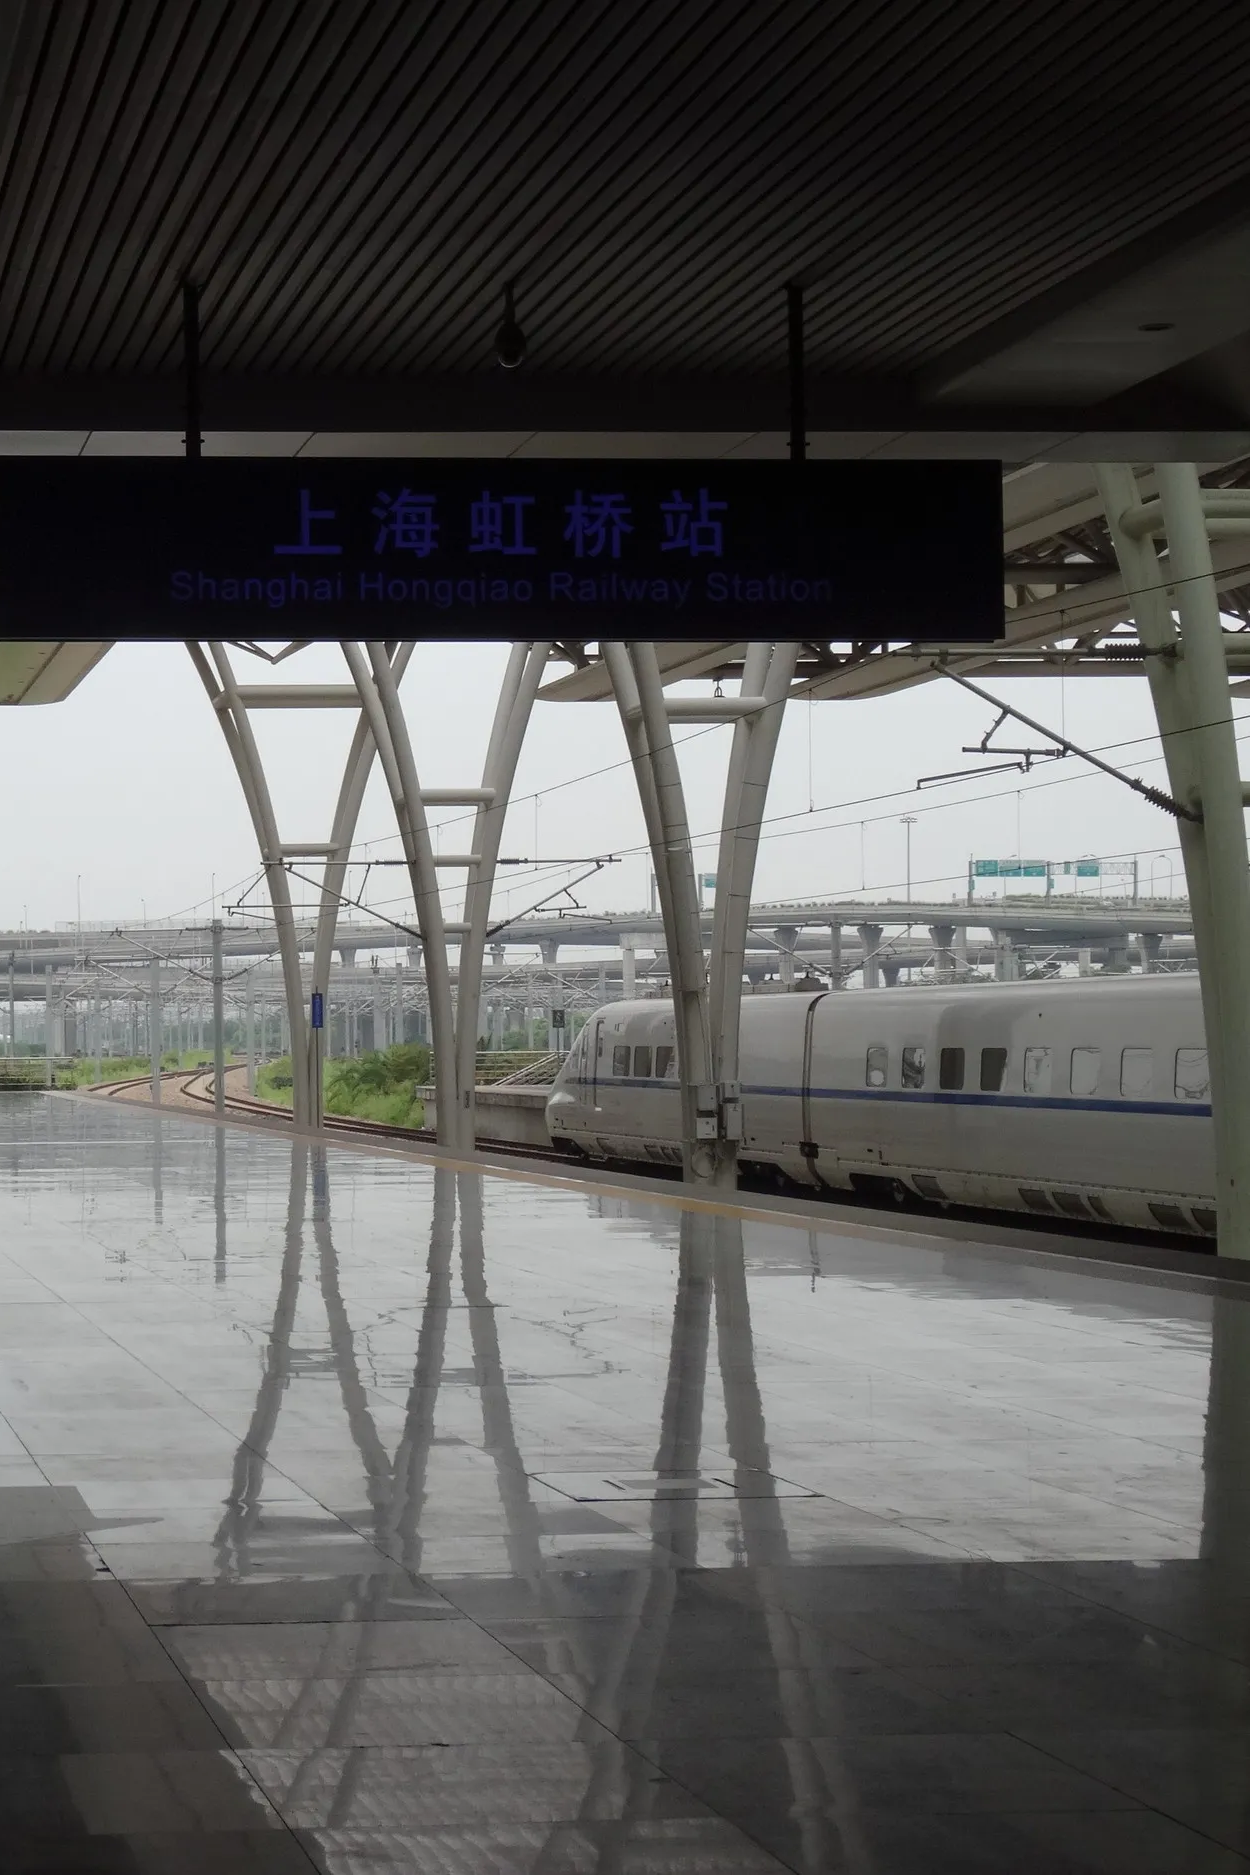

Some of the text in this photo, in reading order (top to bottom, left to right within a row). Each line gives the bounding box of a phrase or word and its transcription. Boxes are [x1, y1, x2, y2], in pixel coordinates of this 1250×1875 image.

[272, 488, 730, 558] 上海虹桥站
[170, 569, 834, 608] Shanghai Hongqiao Railway Station
